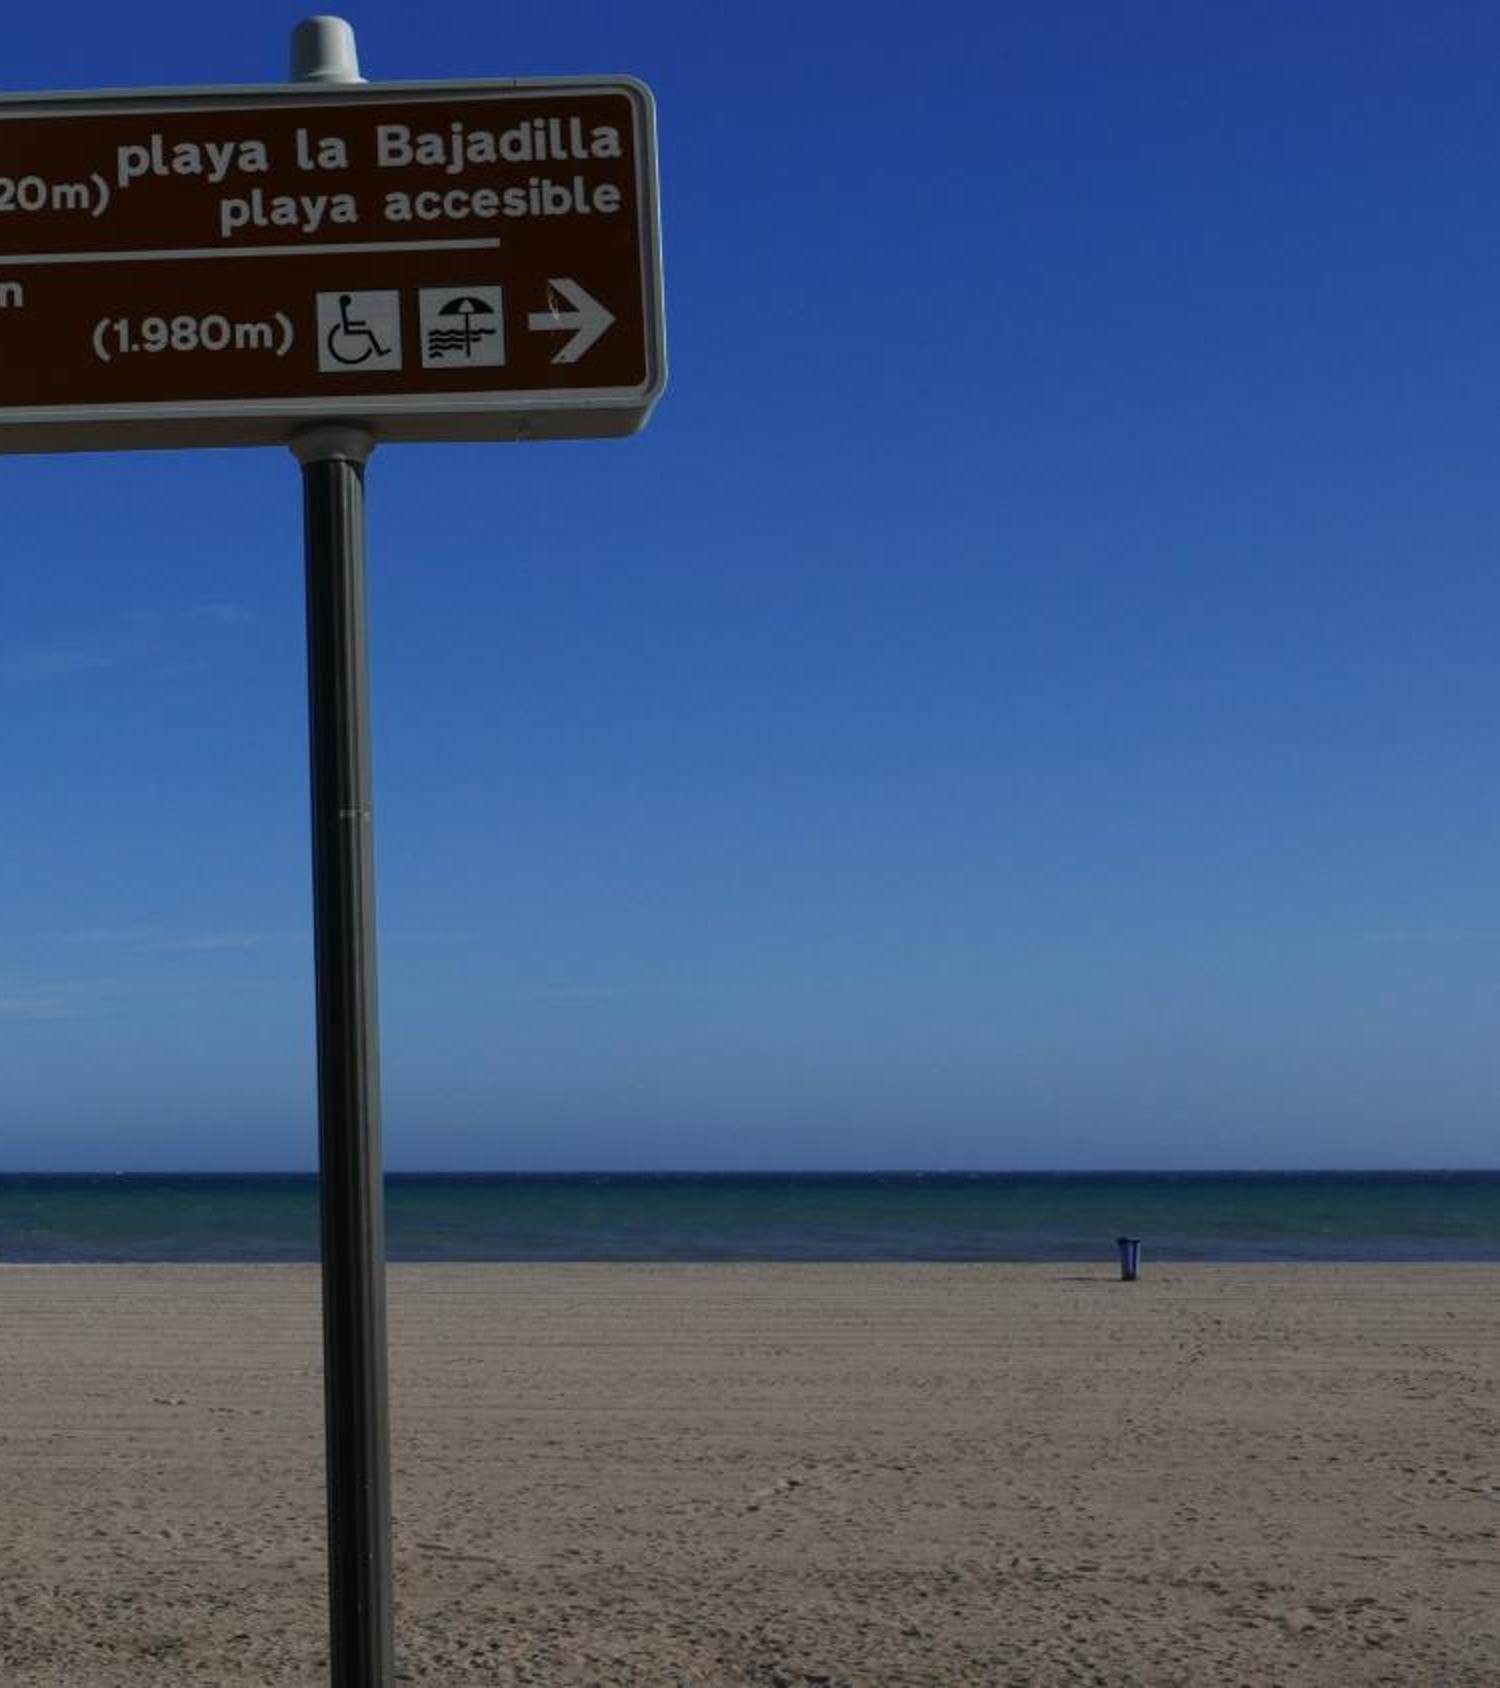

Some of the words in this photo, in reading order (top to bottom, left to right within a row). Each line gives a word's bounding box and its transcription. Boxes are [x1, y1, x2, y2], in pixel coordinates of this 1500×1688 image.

[117, 134, 268, 187] playa
[297, 128, 347, 170] la
[377, 117, 621, 174] Bajadilla
[221, 188, 357, 237] playa
[385, 176, 620, 221] accesible
